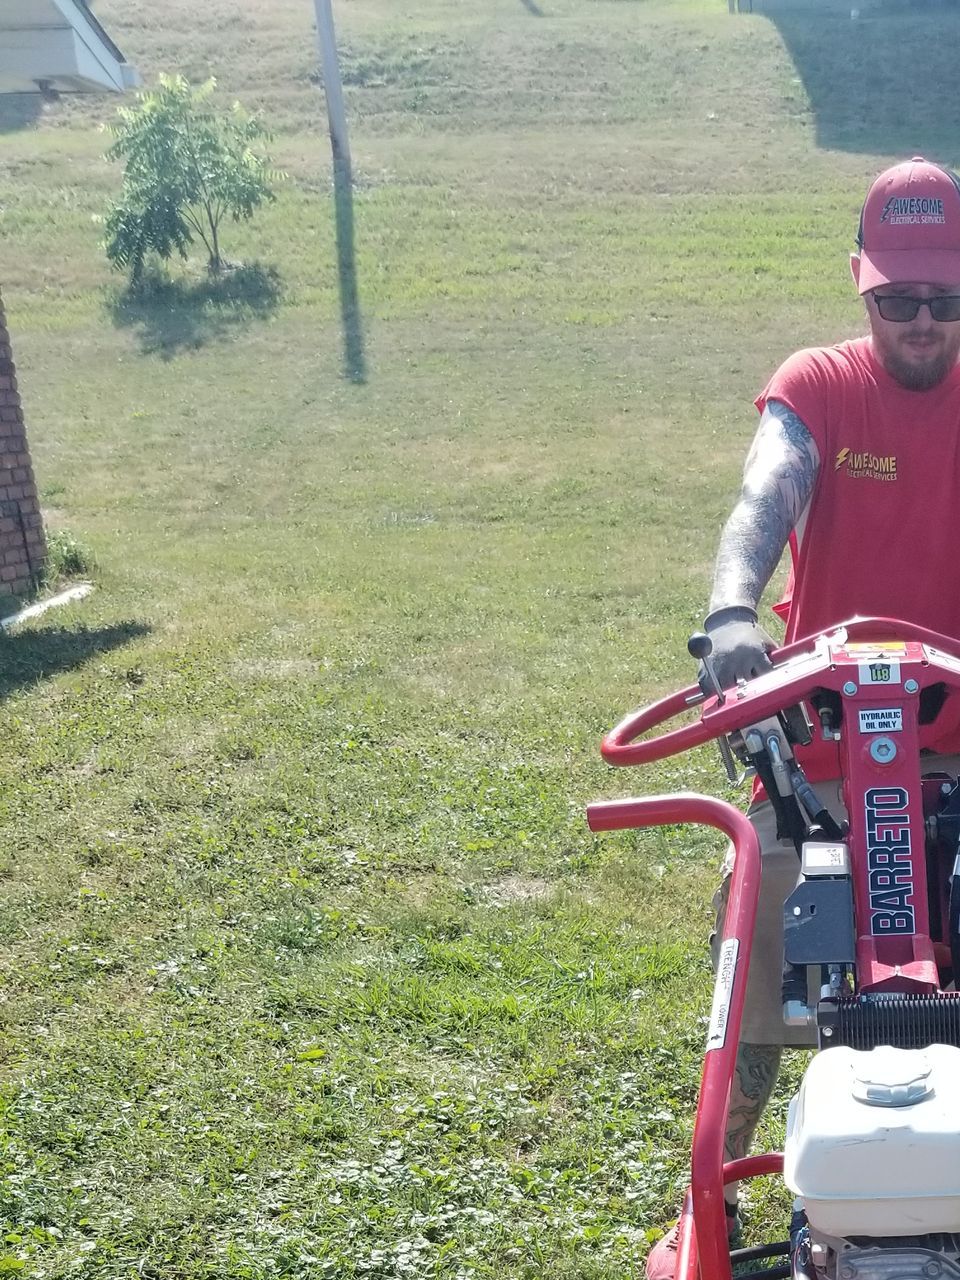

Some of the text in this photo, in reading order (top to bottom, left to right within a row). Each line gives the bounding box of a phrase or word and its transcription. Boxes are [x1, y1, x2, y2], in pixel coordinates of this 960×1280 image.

[893, 198, 944, 215] AWESOME
[890, 216, 946, 225] ELECTRICAL SERVICES
[848, 452, 897, 473] AWESOME
[860, 711, 901, 721] HYDRAULIC
[865, 721, 897, 730] OIL ONLY
[864, 787, 915, 936] BARRETO
[717, 1004, 727, 1029] LOWER
